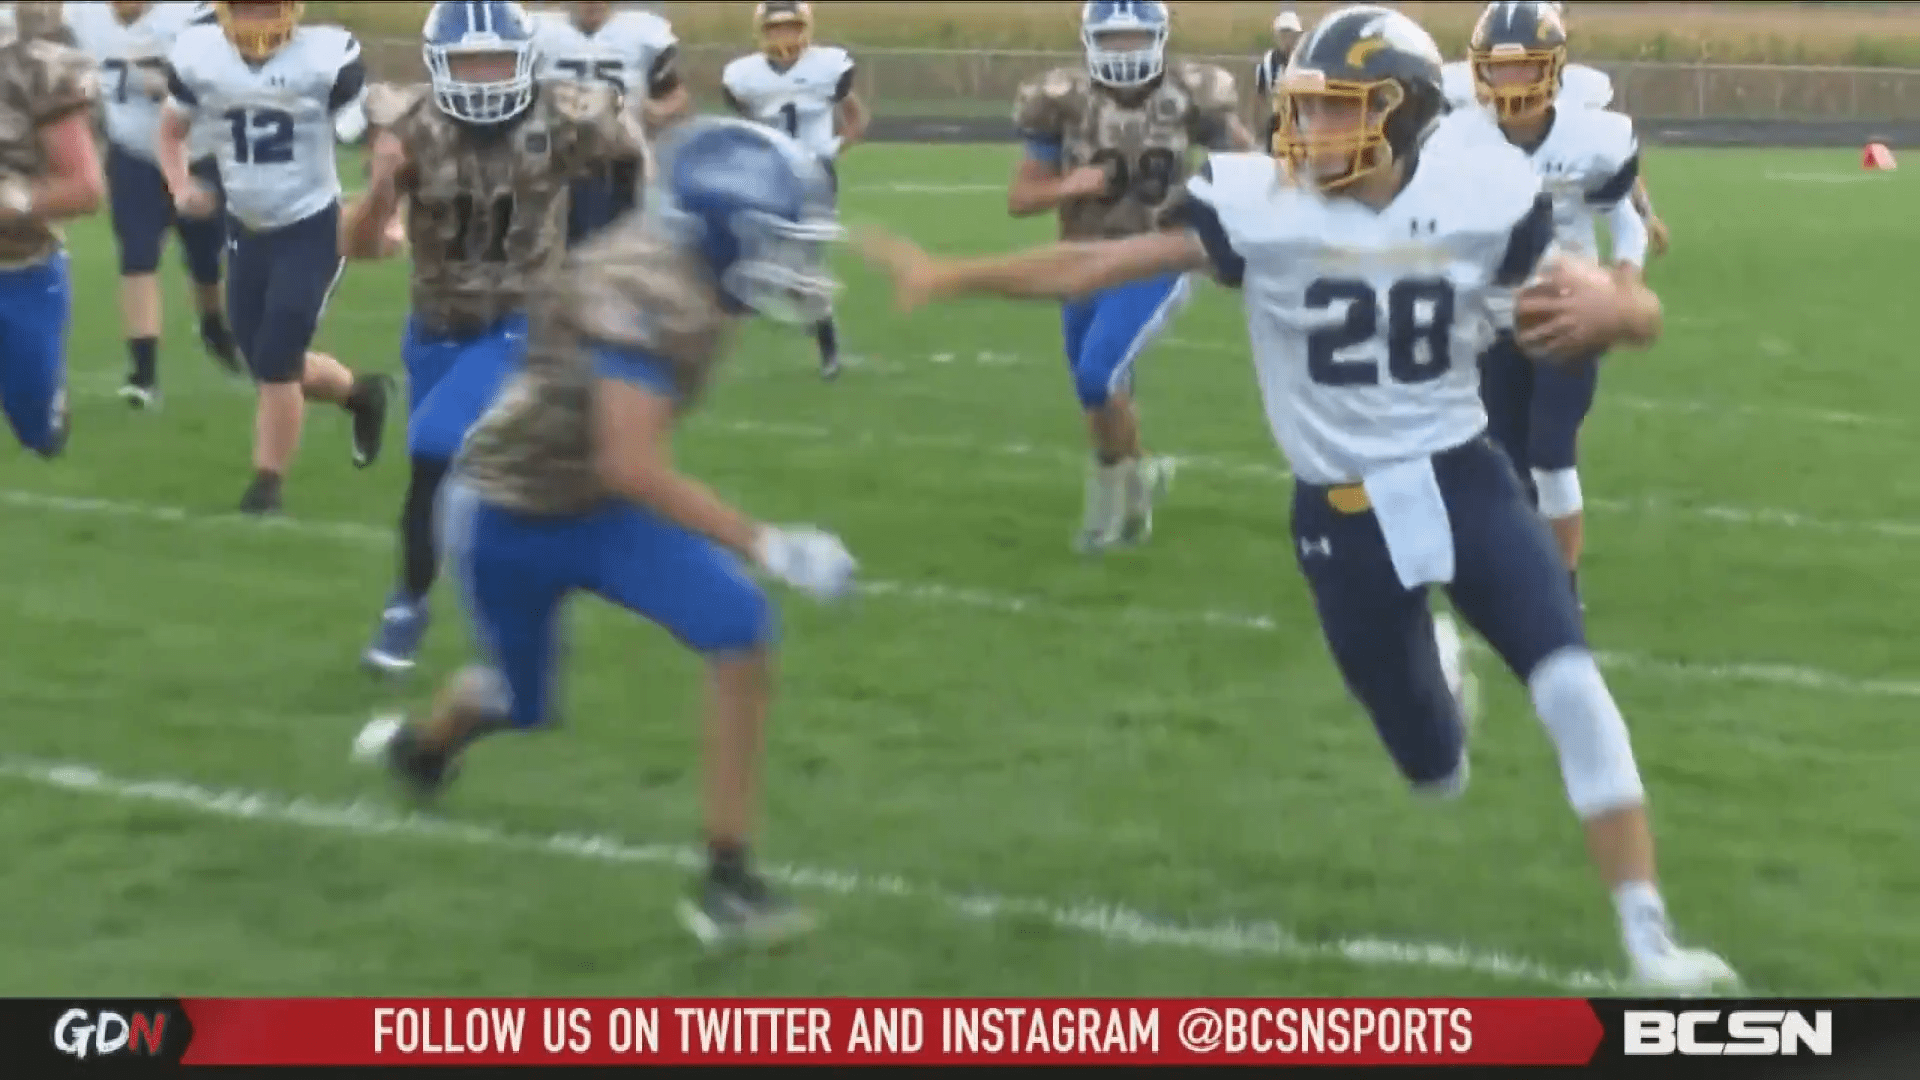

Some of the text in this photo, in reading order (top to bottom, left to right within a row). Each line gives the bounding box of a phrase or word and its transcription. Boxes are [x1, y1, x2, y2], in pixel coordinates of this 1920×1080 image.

[224, 107, 295, 164] 12
[779, 102, 798, 138] 1
[1304, 277, 1454, 386] 28
